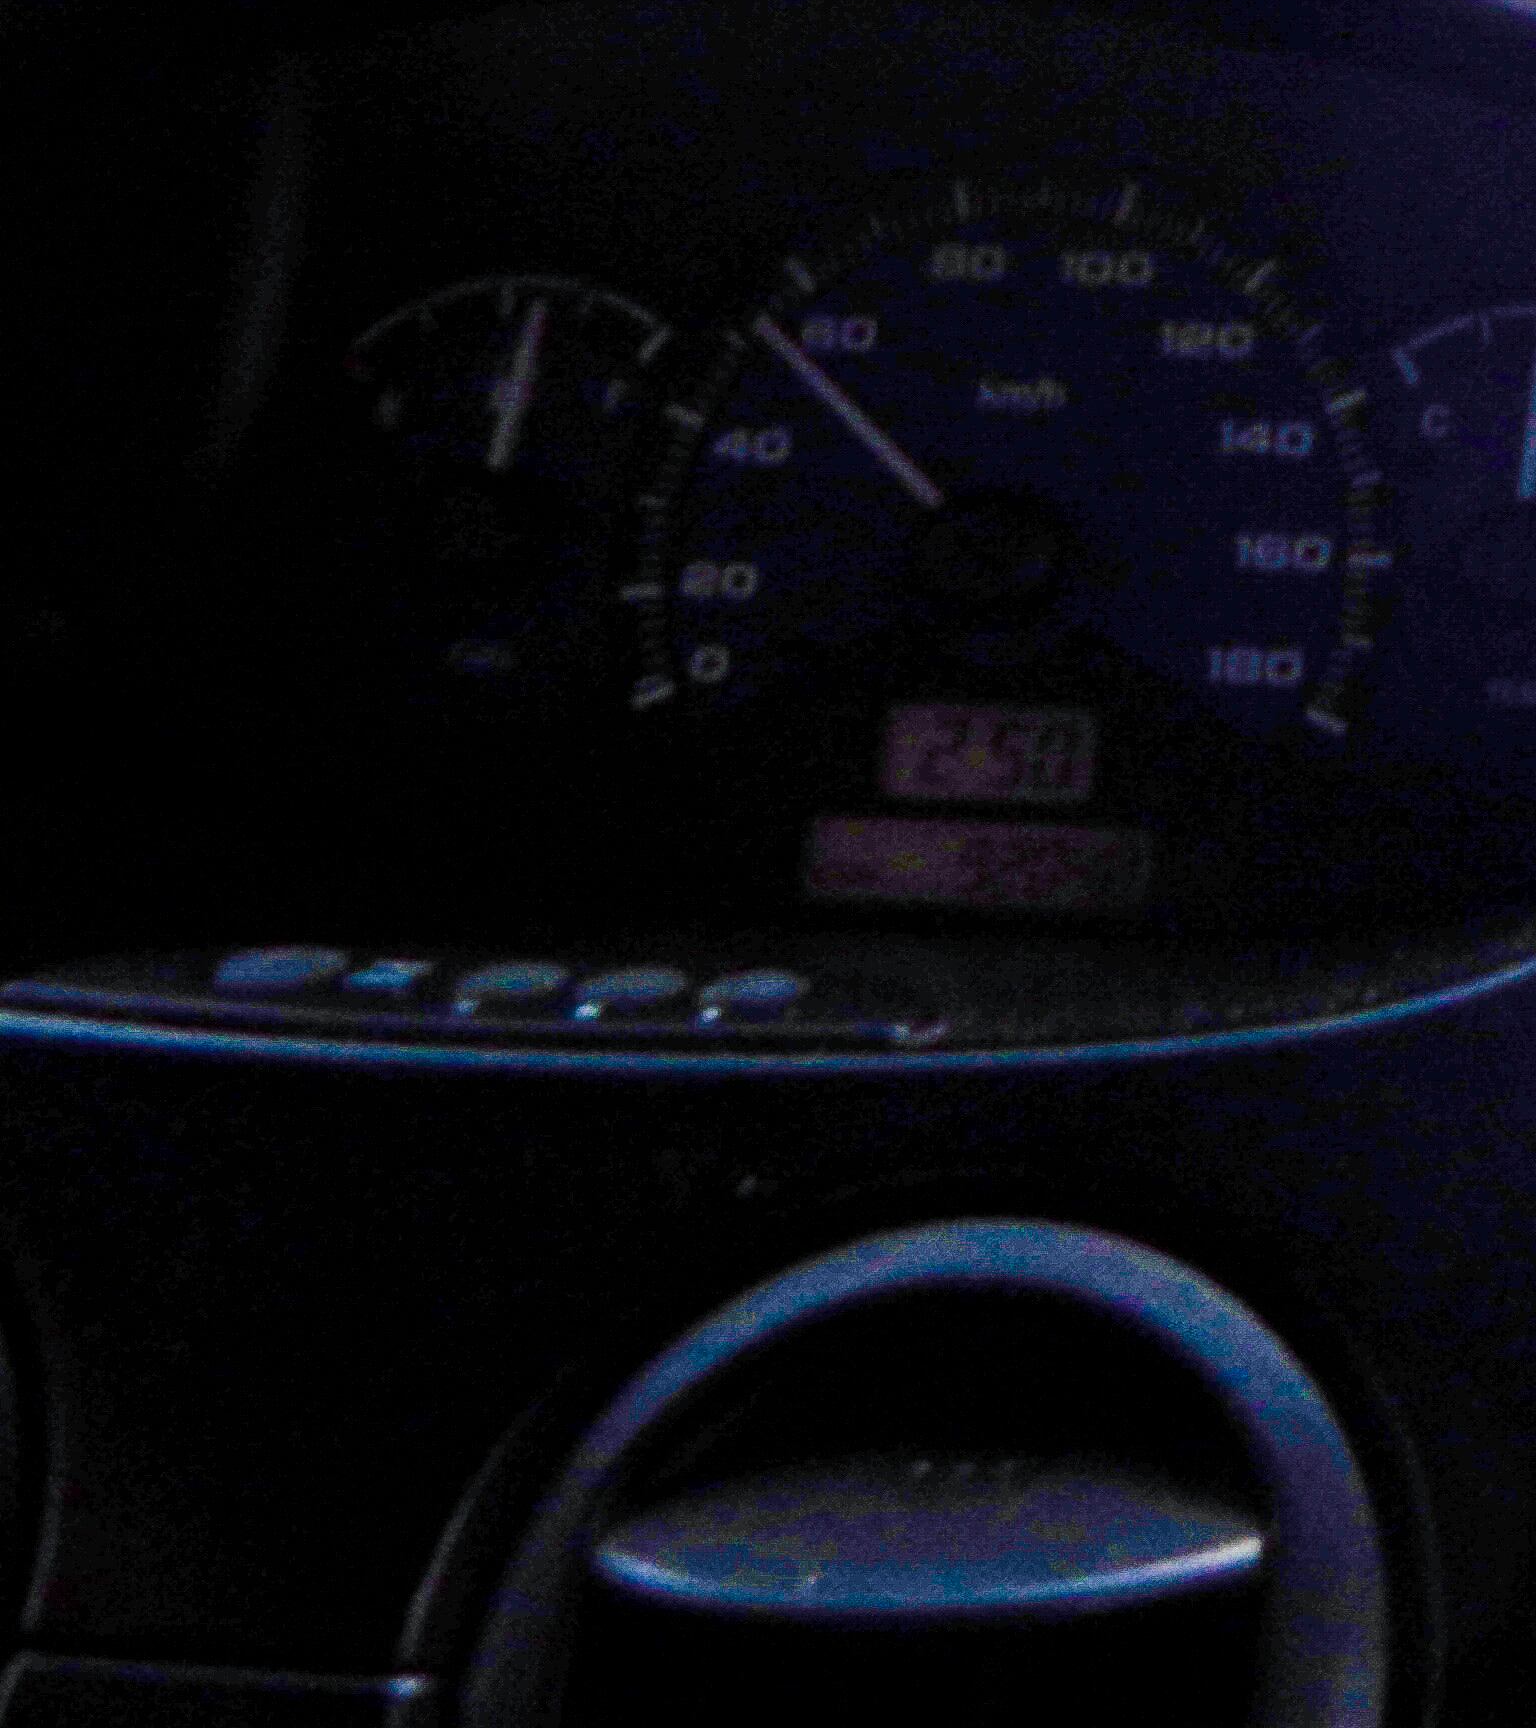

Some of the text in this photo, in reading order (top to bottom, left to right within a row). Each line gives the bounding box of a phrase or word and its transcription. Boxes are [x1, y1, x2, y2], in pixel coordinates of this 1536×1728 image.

[1060, 252, 1155, 287] 100
[713, 427, 791, 465] 40
[1221, 422, 1315, 458] 140
[1236, 534, 1331, 571] 160
[689, 645, 730, 682] 0
[1210, 647, 1303, 685] 180
